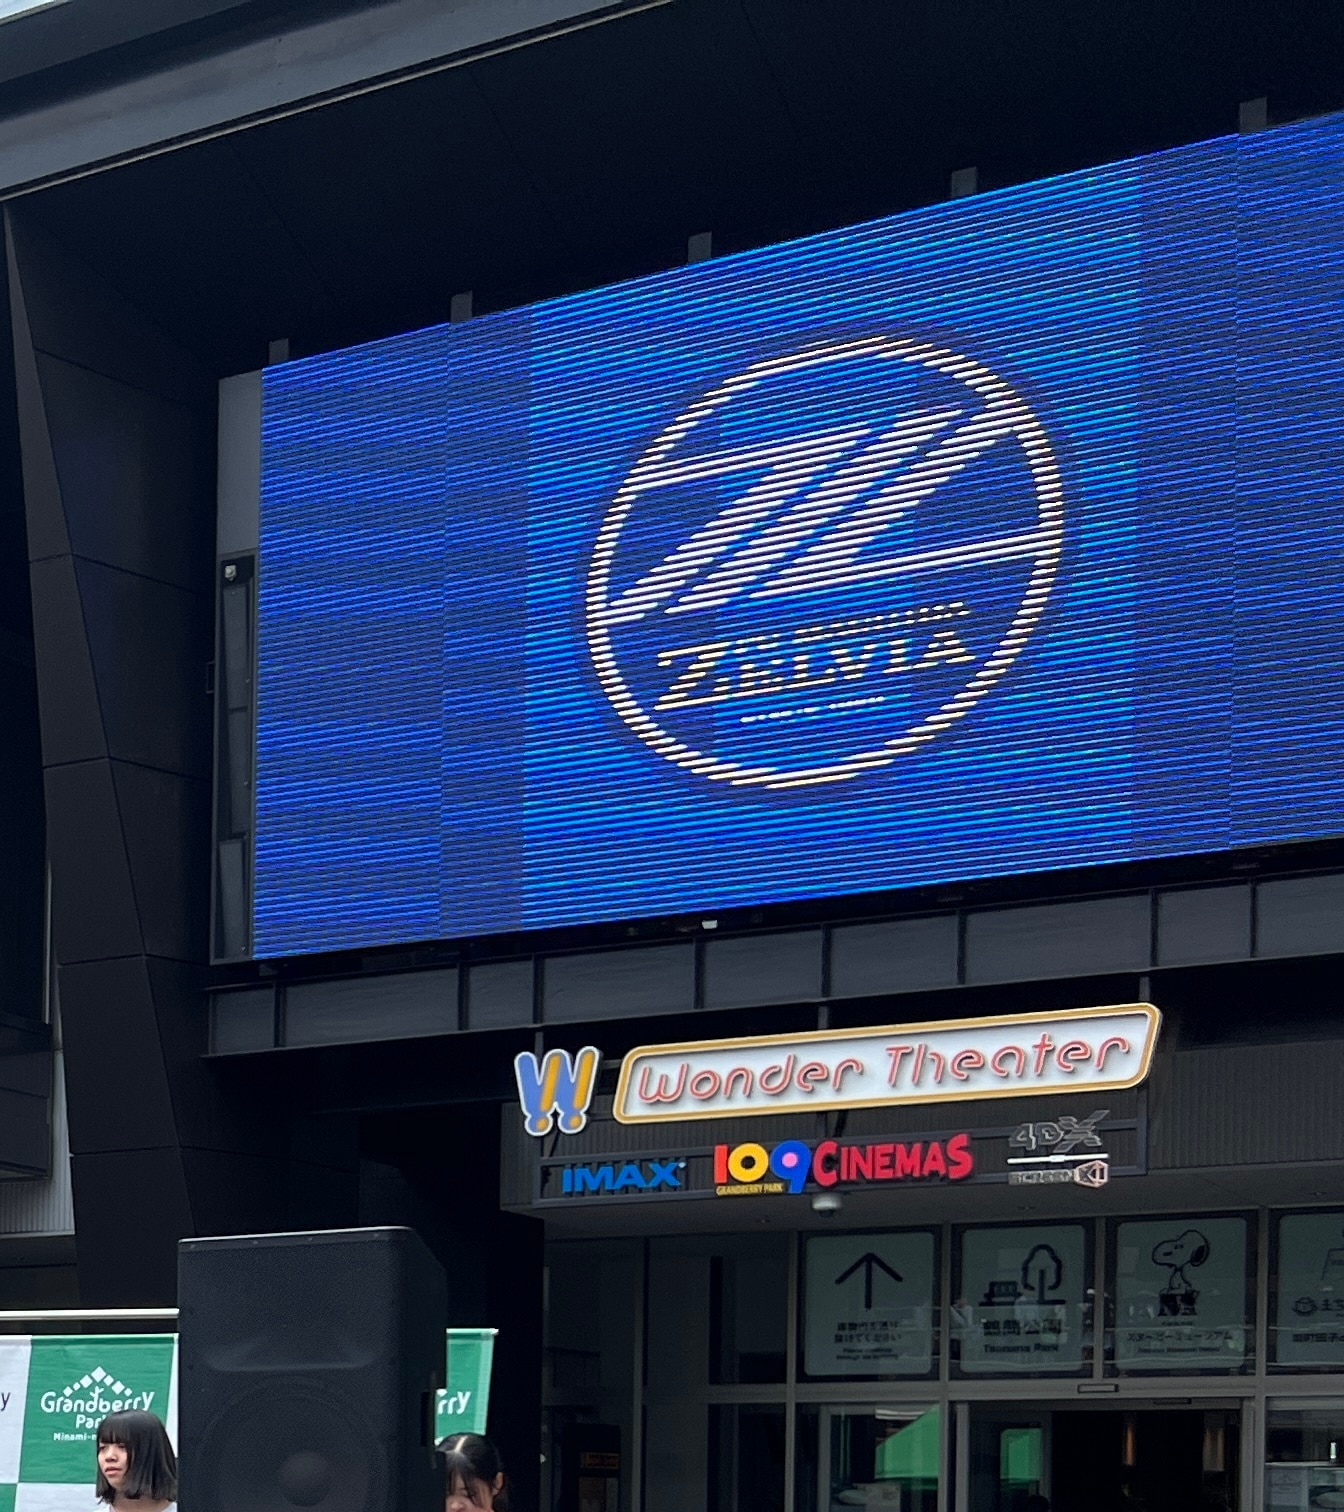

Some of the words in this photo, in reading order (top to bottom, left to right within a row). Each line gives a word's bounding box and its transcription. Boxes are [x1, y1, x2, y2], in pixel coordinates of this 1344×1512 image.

[637, 1057, 864, 1105] Wonder
[886, 1032, 1131, 1087] Theater
[1008, 1110, 1111, 1153] 4DX
[562, 1161, 681, 1195] IMAX
[714, 1140, 811, 1194] 109
[813, 1133, 974, 1187] CINEMAS
[40, 1385, 155, 1413] Grandberry
[75, 1414, 105, 1429] Par
